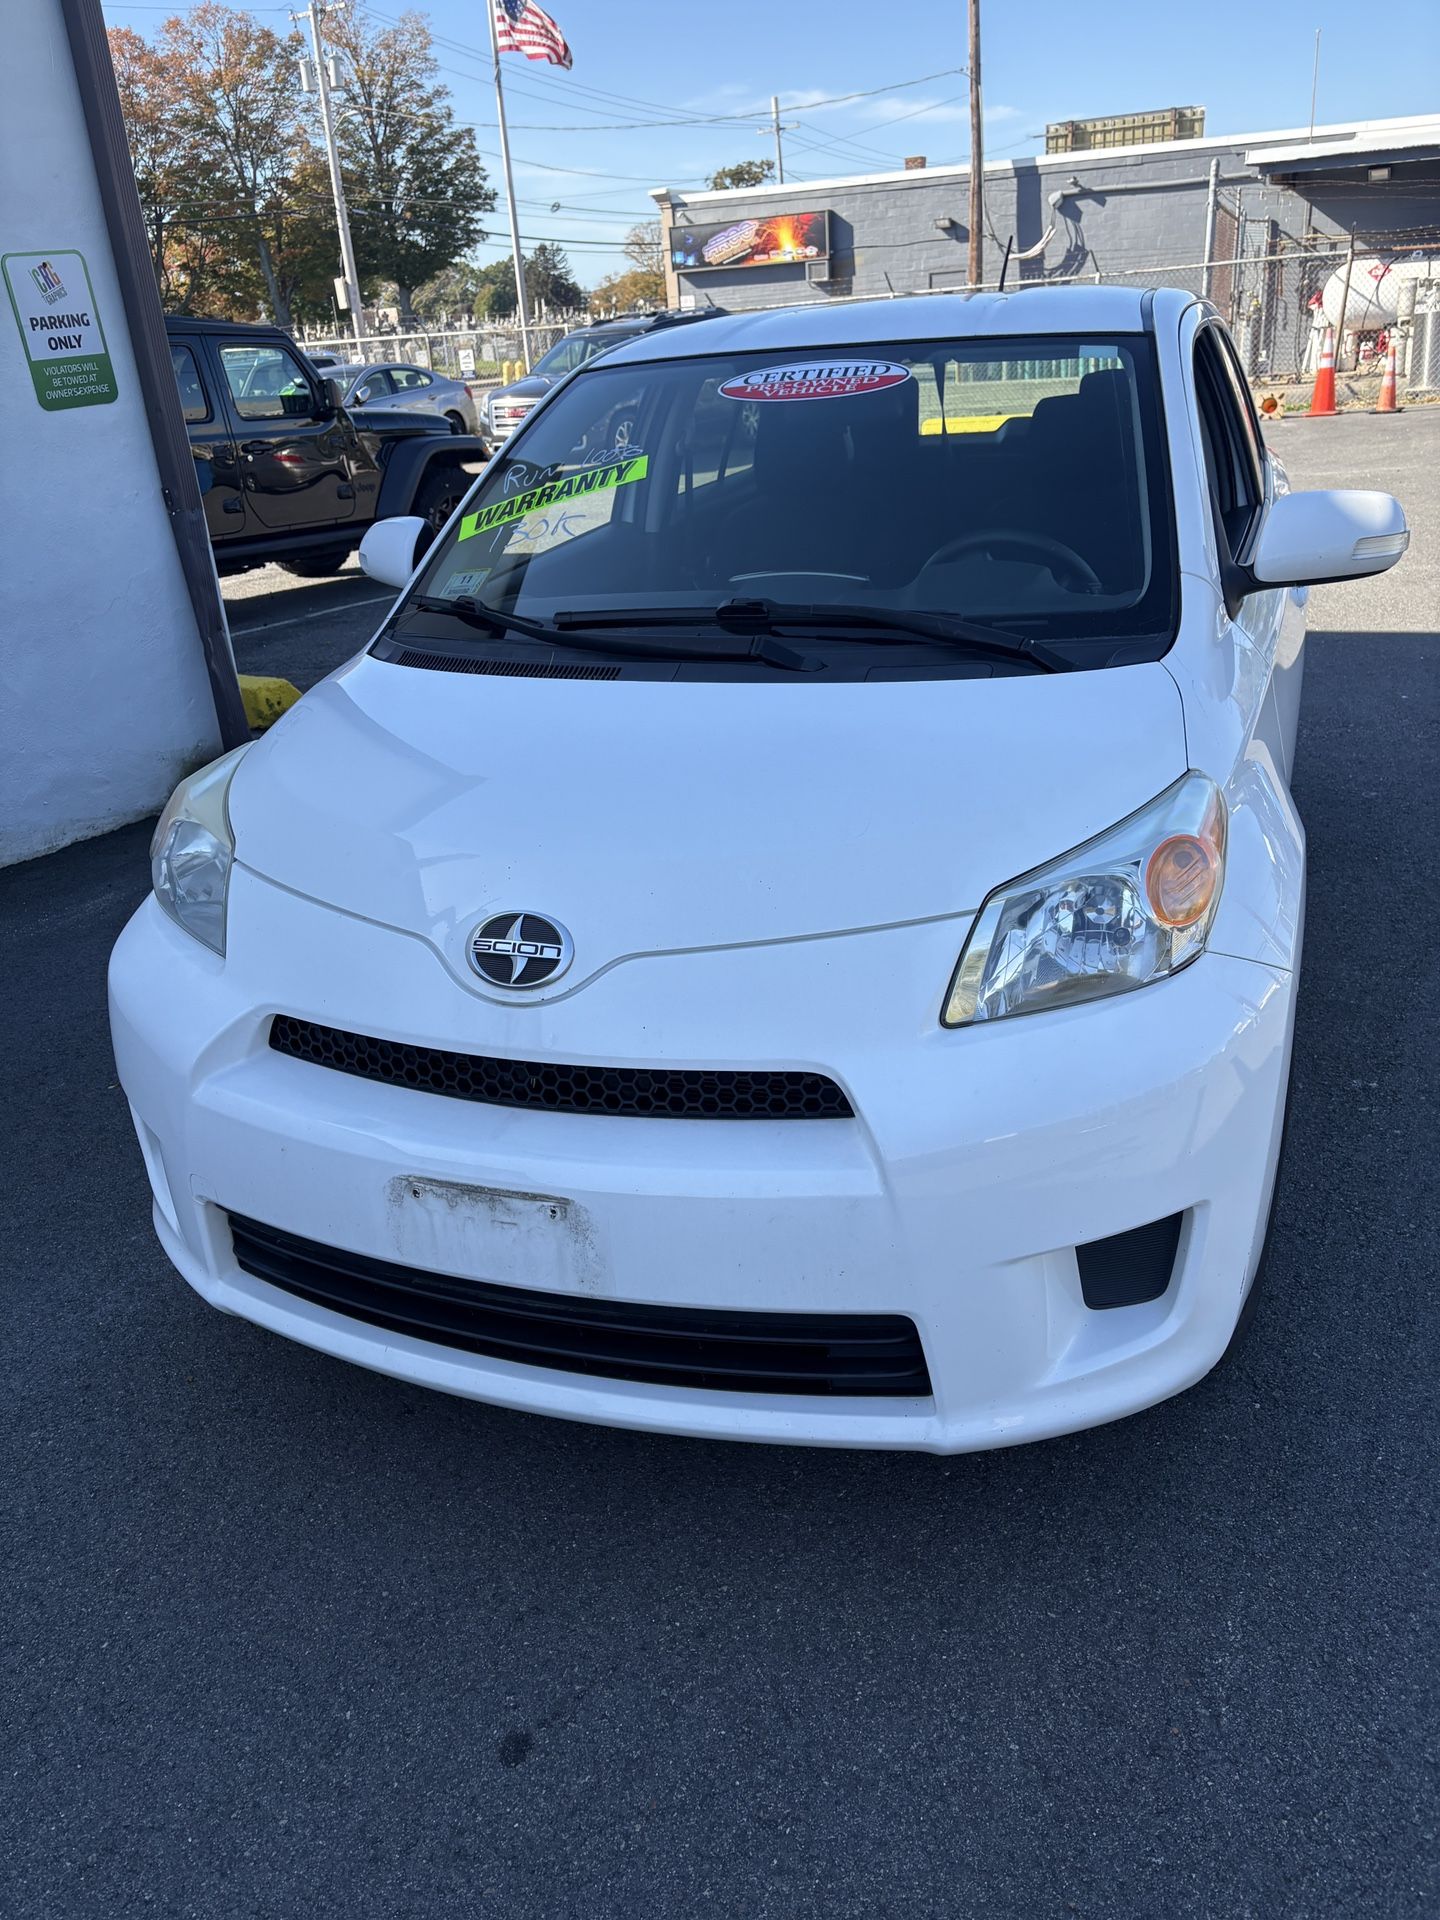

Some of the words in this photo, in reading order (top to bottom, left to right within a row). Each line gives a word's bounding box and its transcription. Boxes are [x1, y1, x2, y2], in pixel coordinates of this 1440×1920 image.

[29, 312, 91, 331] PARKING
[47, 334, 82, 351] ONLY
[43, 363, 82, 376] VIOLATORS
[82, 361, 99, 371] WILL
[743, 364, 891, 386] CERTIFIED
[52, 377, 63, 387] BE
[63, 374, 88, 386] TOWED
[88, 374, 97, 382] AT
[745, 376, 880, 393] PRE-OWNED
[79, 383, 110, 396] EXPENSE
[763, 384, 857, 398] VEHICLE
[473, 459, 640, 532] WARRANTY
[472, 939, 562, 958] SCION
